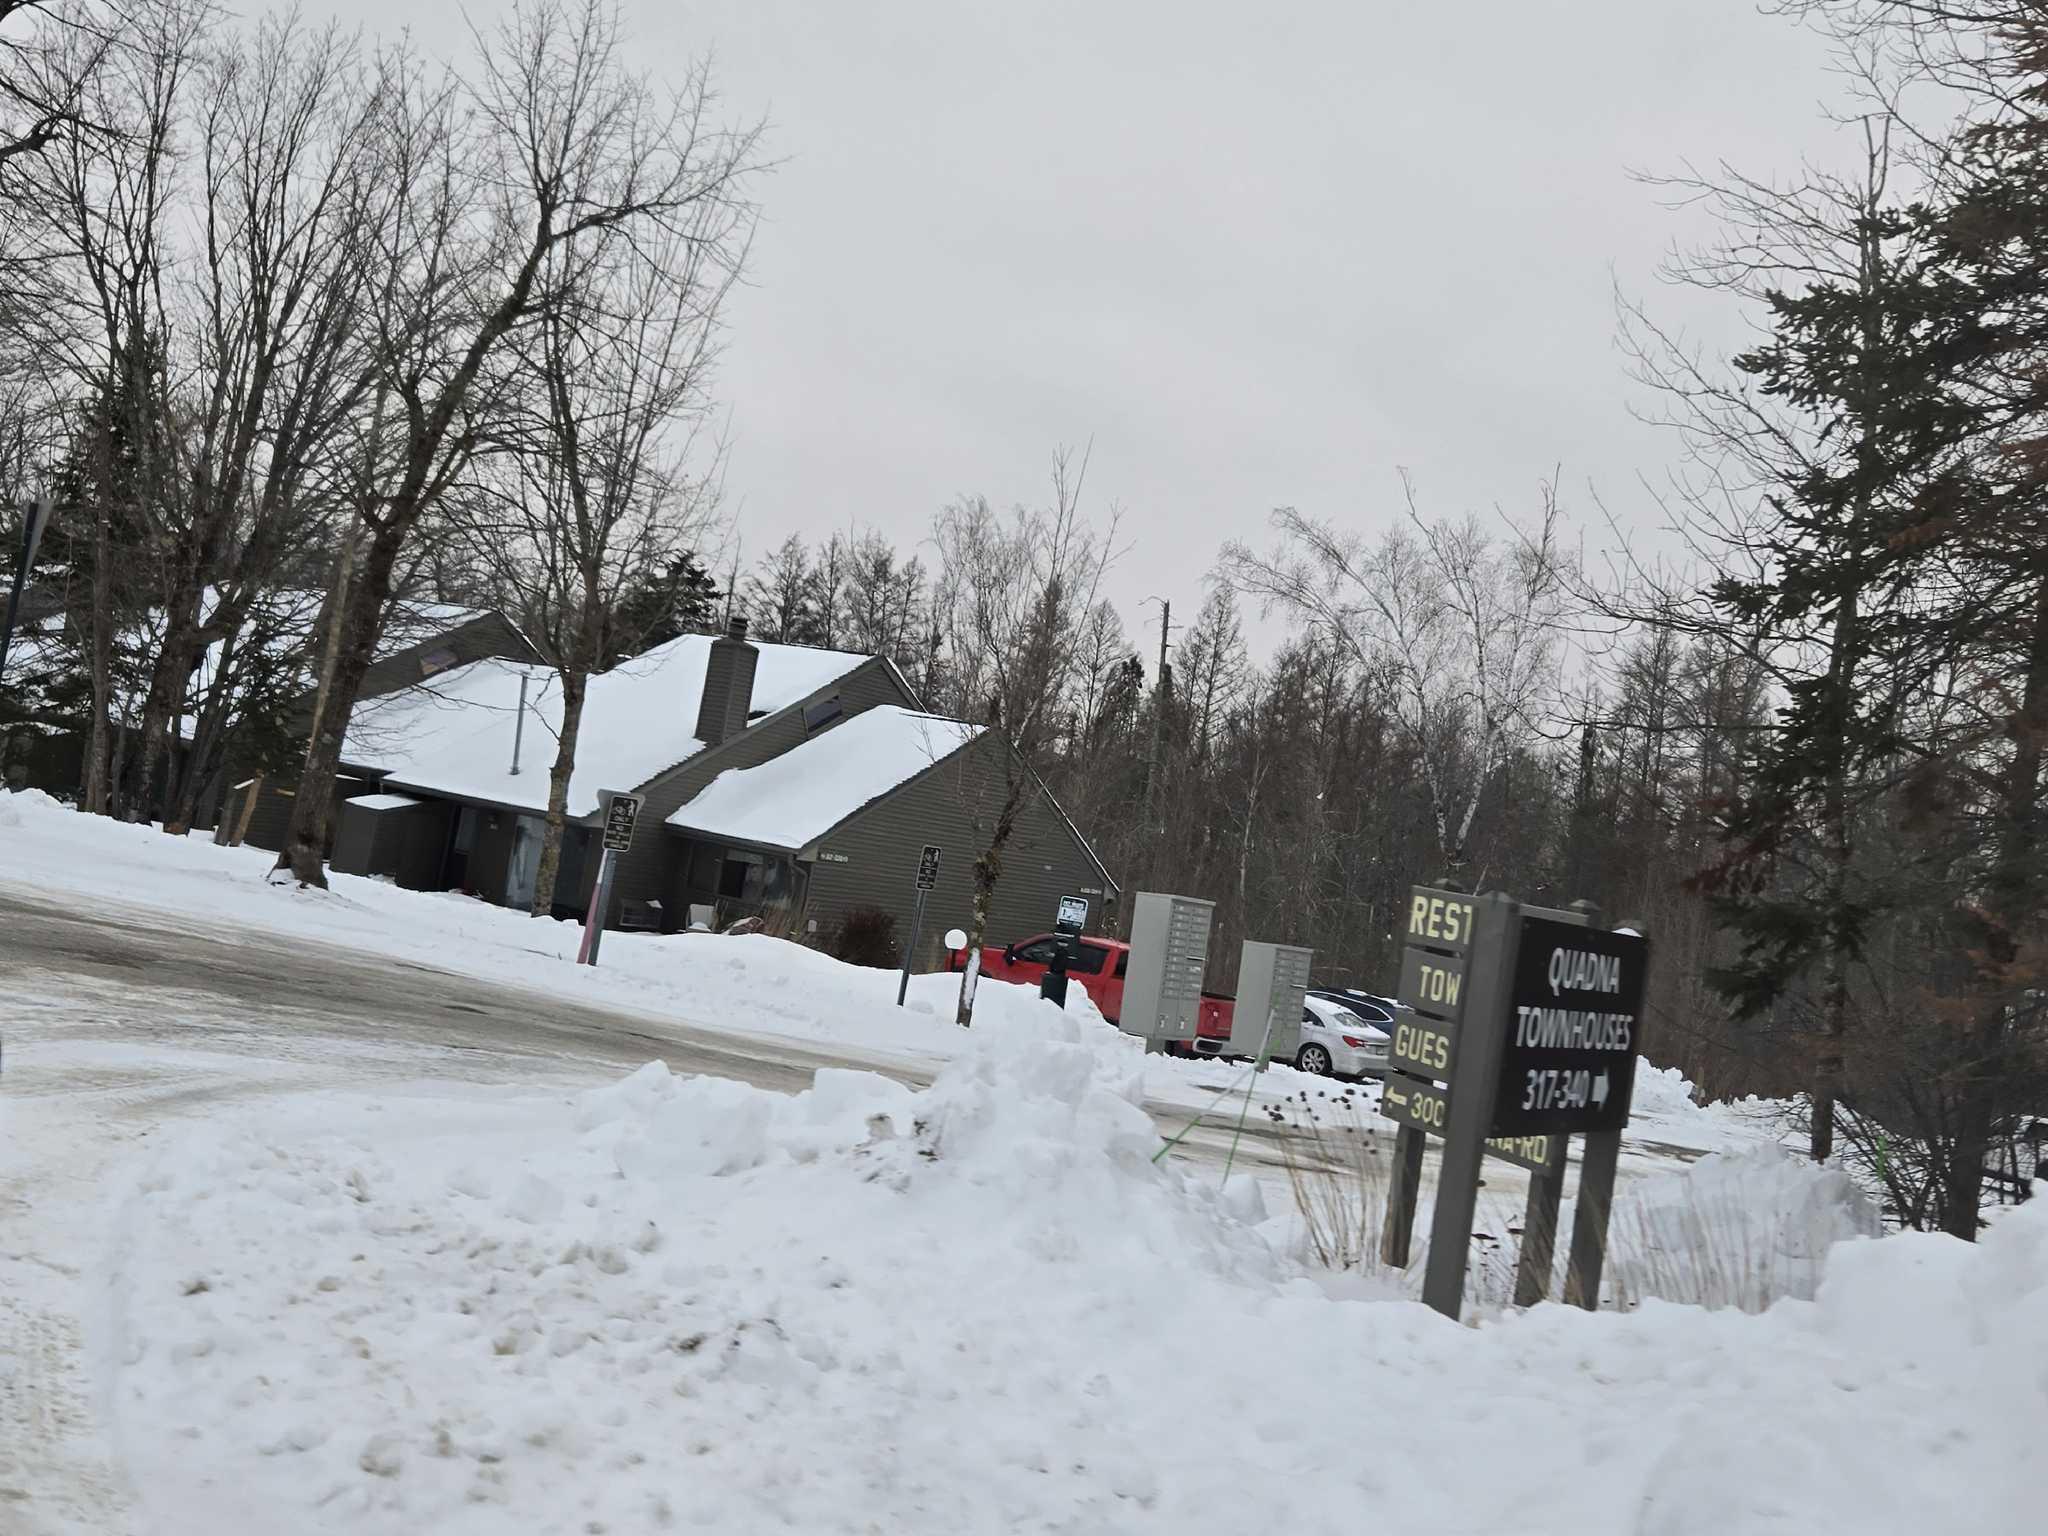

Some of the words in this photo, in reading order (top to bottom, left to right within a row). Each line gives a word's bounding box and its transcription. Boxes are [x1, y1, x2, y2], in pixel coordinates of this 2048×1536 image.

[1420, 965, 1462, 1006] TOW
[1549, 947, 1621, 996] QUADNA
[1395, 1024, 1449, 1069] GUES
[1516, 1005, 1633, 1050] TOWNHOUSES
[1521, 1069, 1590, 1111] 317-340
